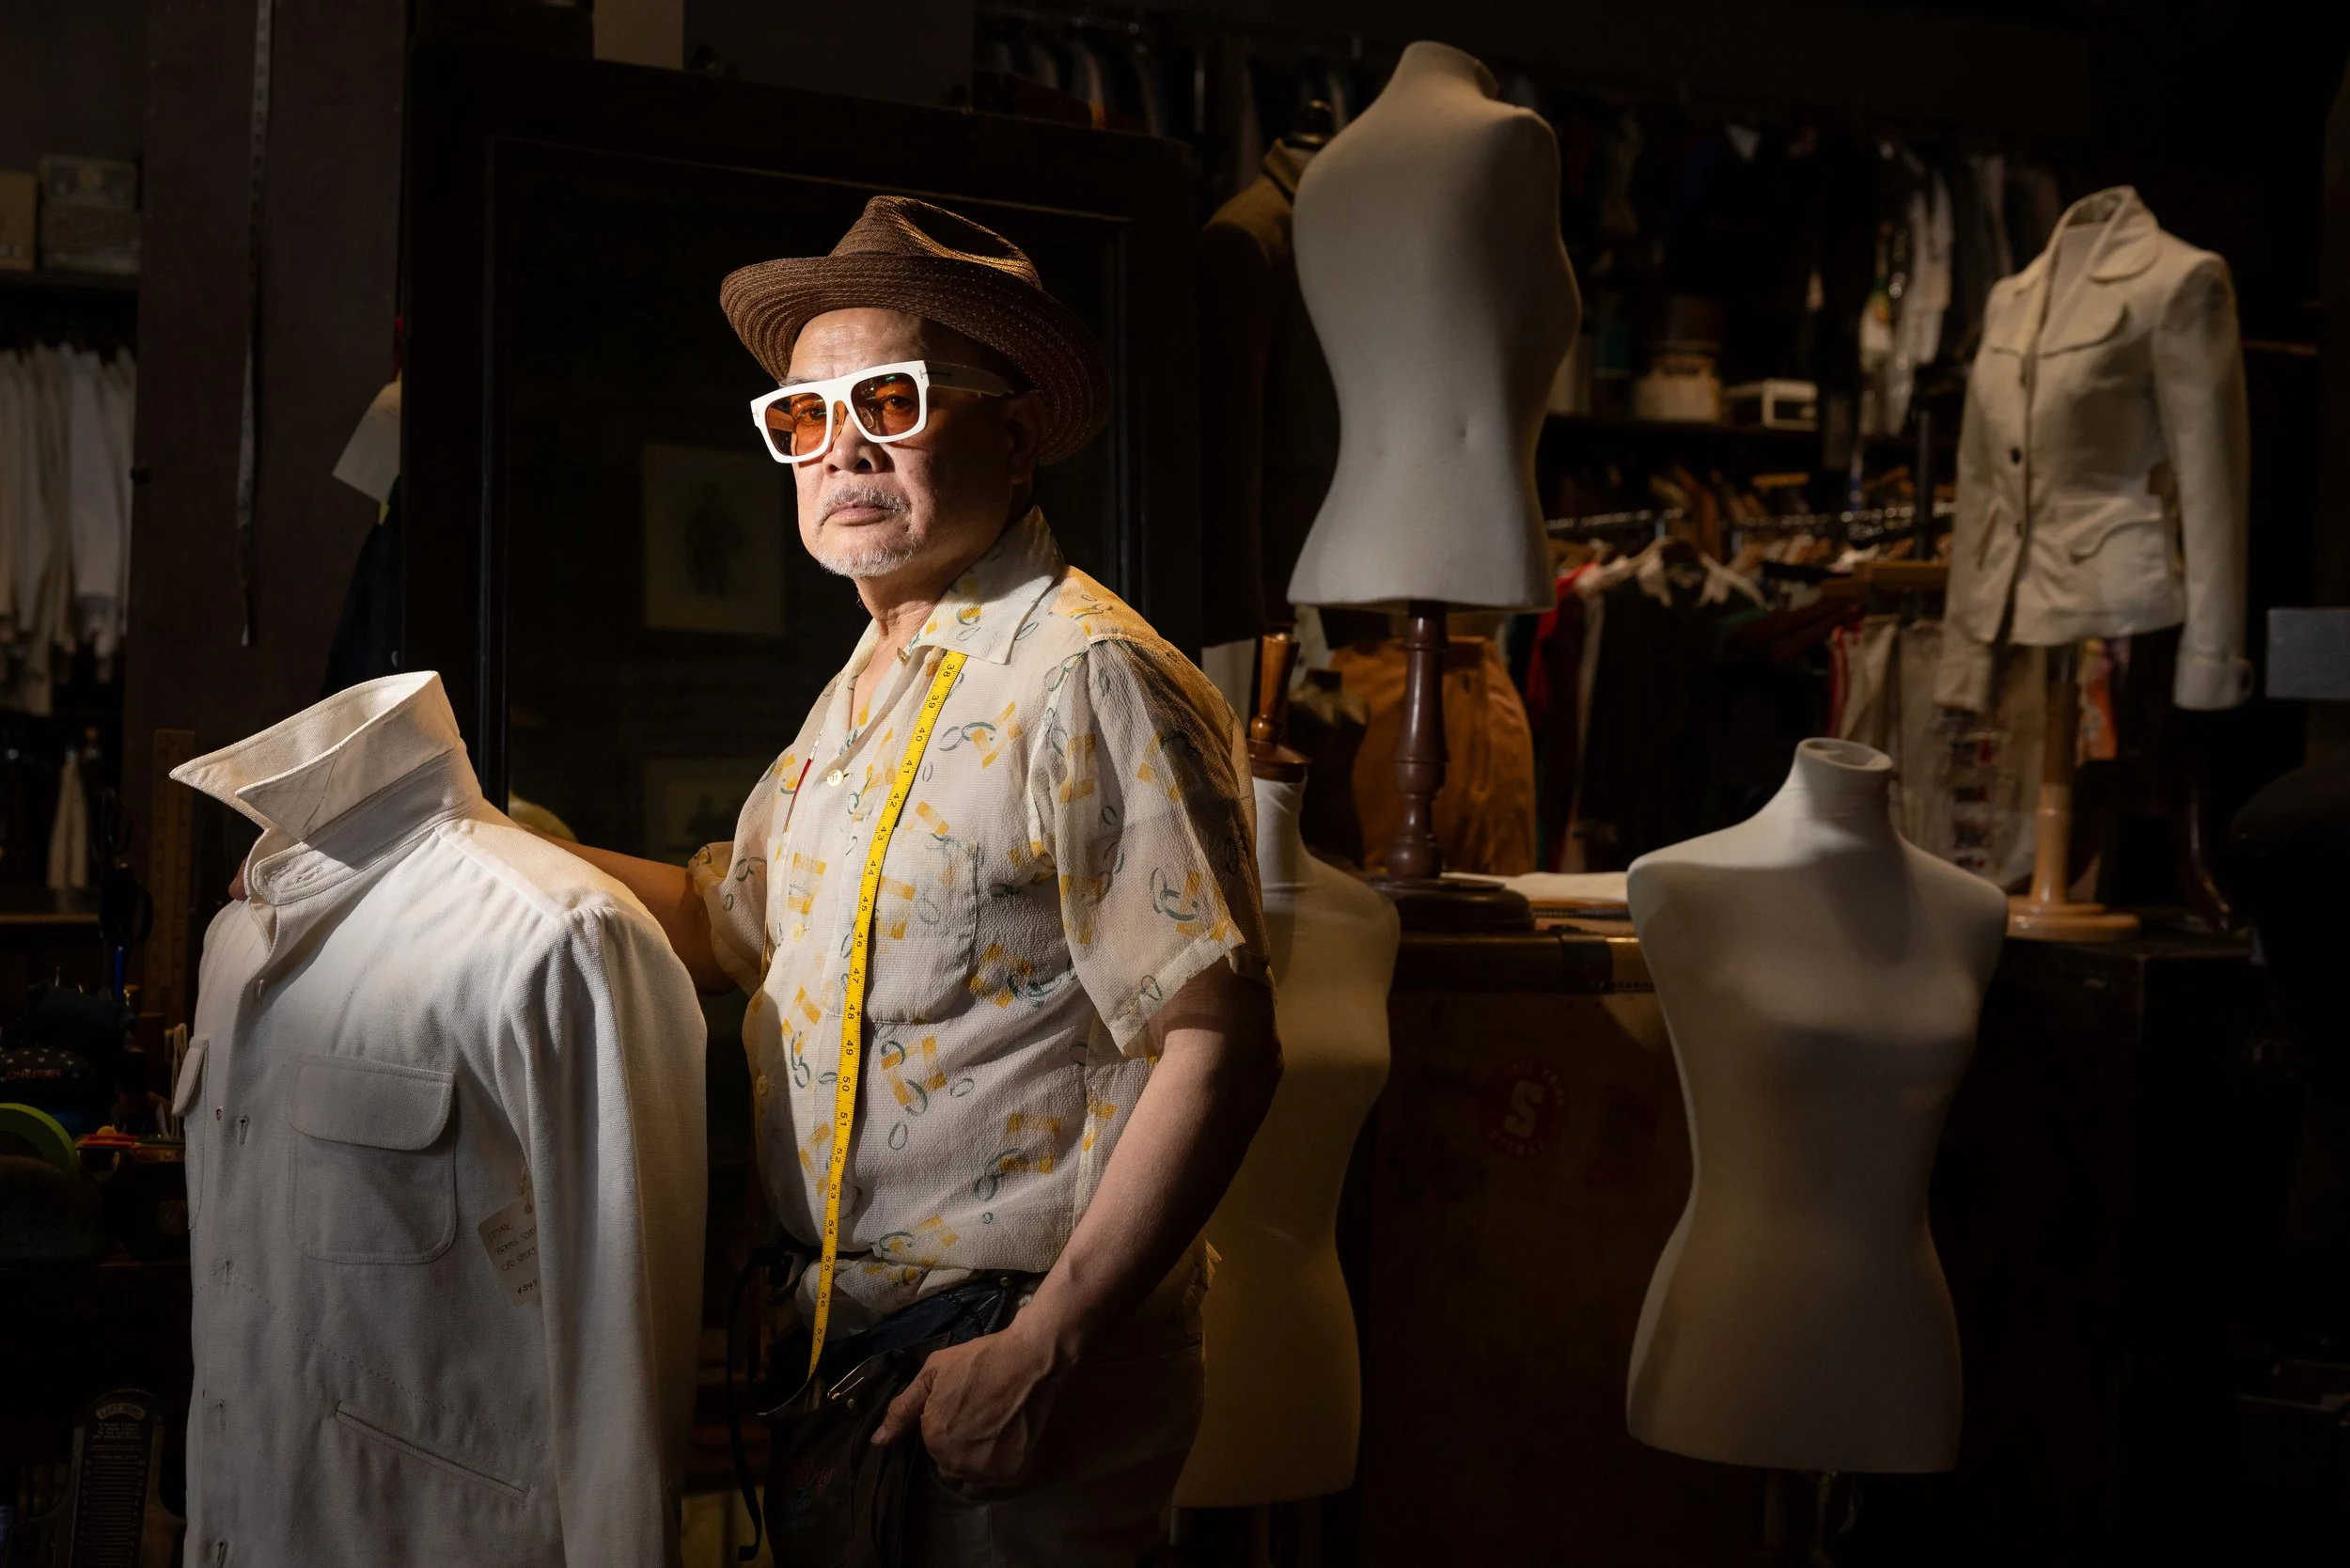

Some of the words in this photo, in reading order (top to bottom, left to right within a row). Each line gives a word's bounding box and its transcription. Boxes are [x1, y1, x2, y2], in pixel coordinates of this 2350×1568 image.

[943, 664, 955, 678] 38
[929, 695, 939, 709] 39
[916, 727, 926, 742] 40
[903, 760, 913, 775] 41
[890, 792, 900, 808] 42
[878, 825, 886, 841] 43
[868, 860, 876, 876] 44
[861, 896, 869, 912] 45
[856, 932, 864, 948] 46
[853, 967, 860, 984] 47
[848, 1004, 855, 1020] 48
[845, 1040, 854, 1056] 49
[841, 1075, 851, 1092] 50
[1503, 1079, 1545, 1138] S
[840, 1112, 848, 1127] 51
[835, 1148, 842, 1164] 52
[830, 1184, 837, 1200] 53
[828, 1219, 834, 1235] 54
[824, 1255, 831, 1272] 55
[821, 1292, 826, 1308] 56
[817, 1328, 822, 1344] 57
